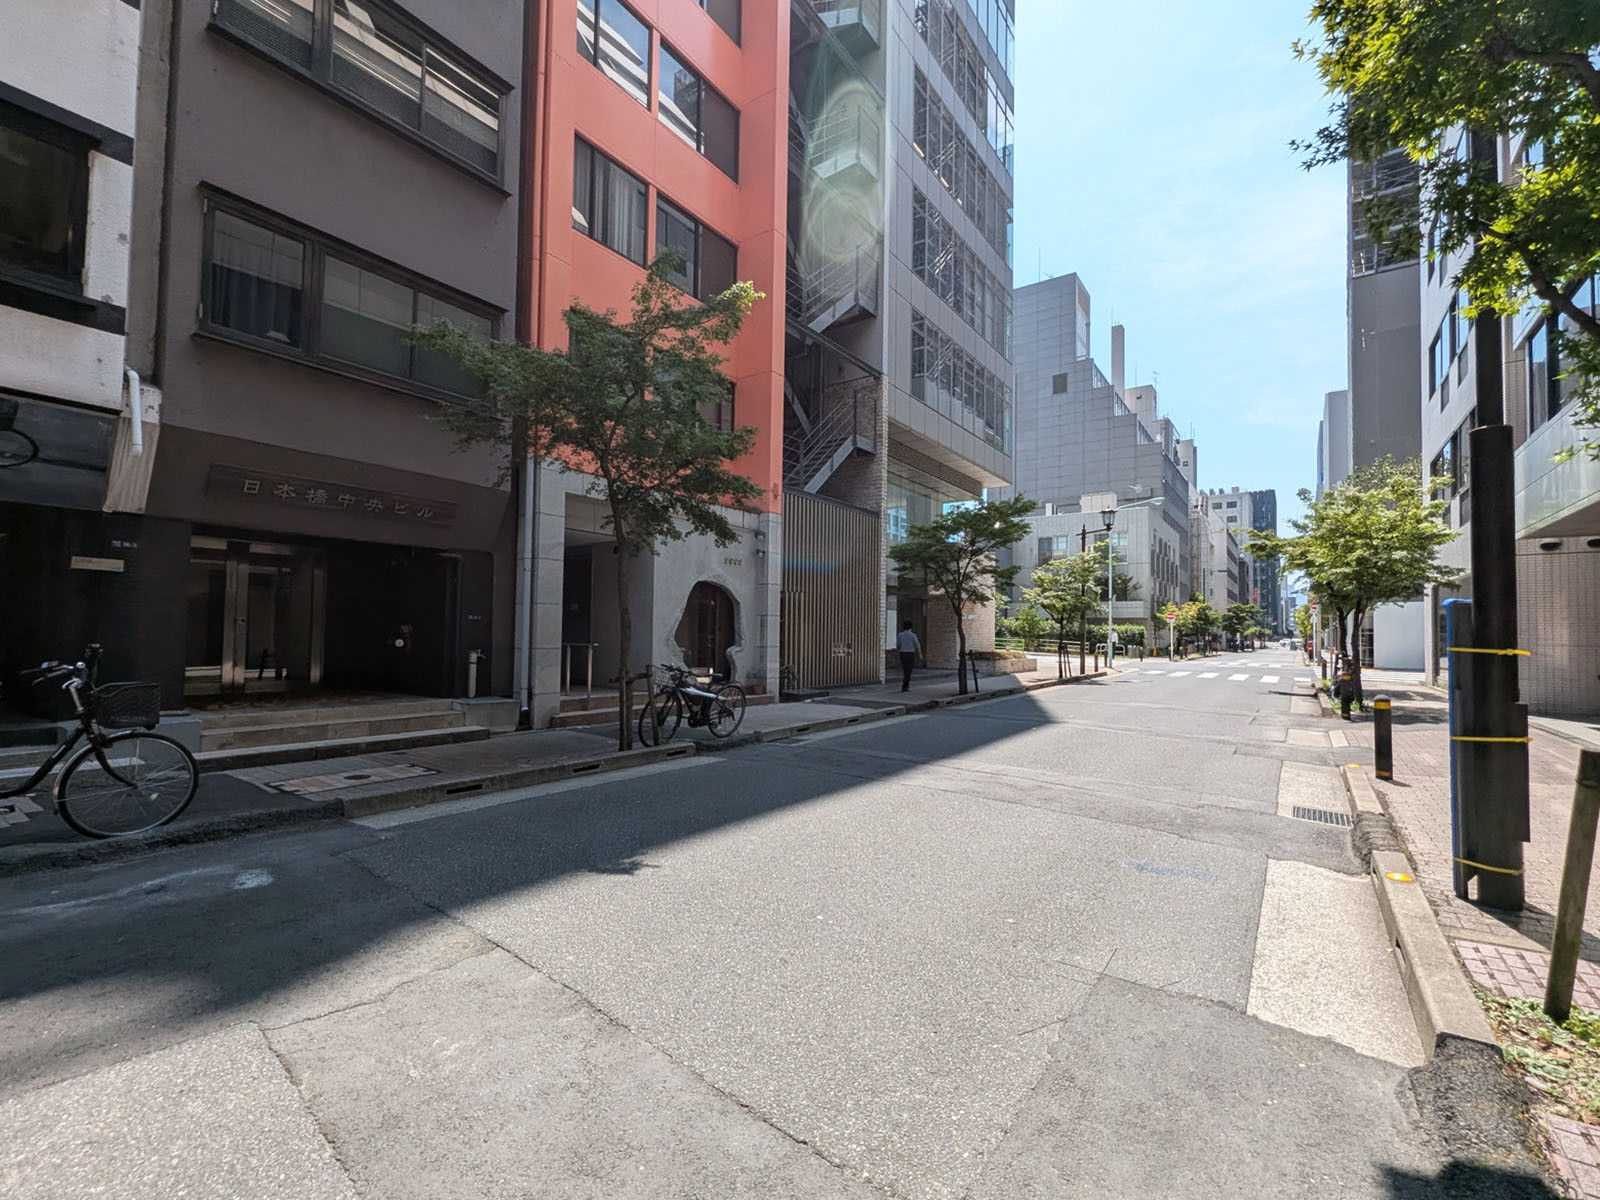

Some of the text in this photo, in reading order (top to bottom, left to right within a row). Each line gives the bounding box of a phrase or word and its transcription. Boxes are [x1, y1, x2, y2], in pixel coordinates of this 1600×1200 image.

[242, 478, 434, 519] 日本橋中央ビル
